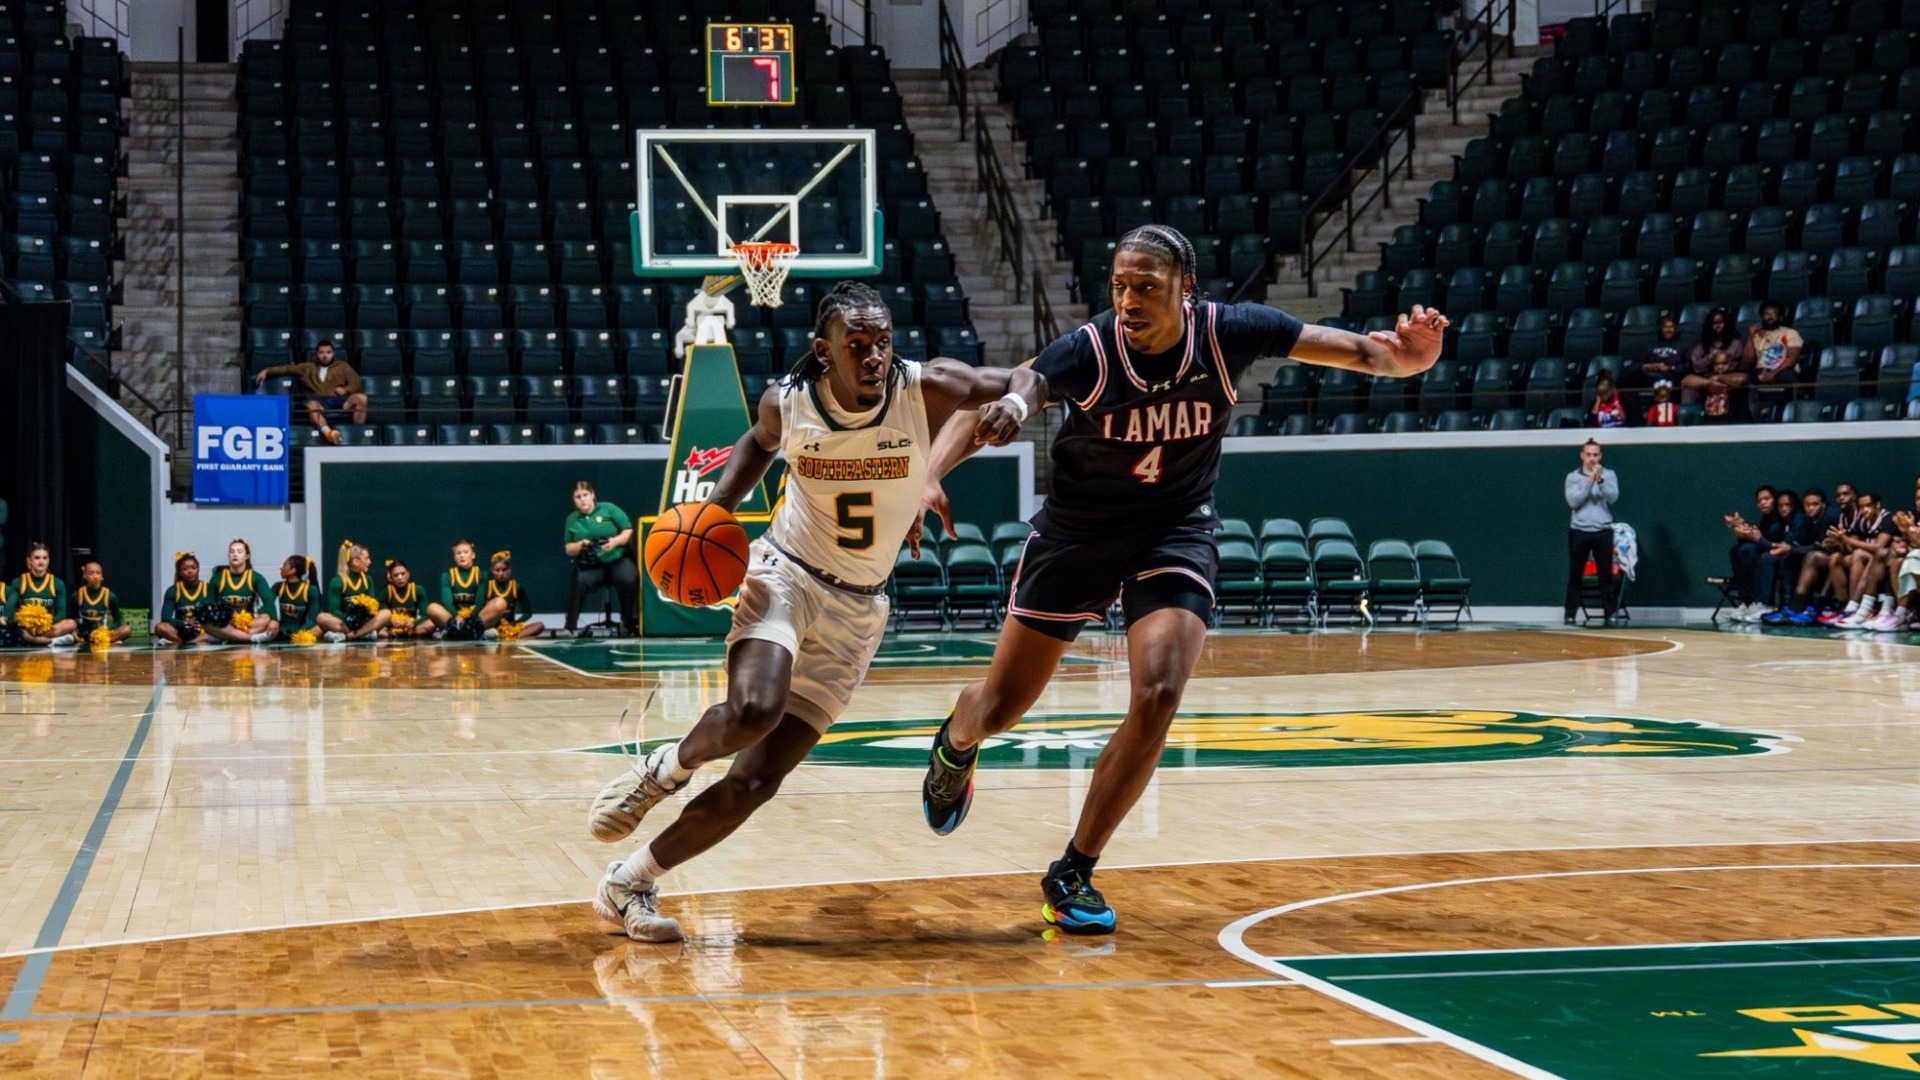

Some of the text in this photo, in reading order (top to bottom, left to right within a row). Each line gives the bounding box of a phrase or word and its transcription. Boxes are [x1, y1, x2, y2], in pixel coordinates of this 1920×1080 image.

[753, 58, 778, 100] 7
[1103, 401, 1213, 442] LAMAR
[197, 425, 284, 460] FGB
[196, 463, 285, 471] FIRST GUARANTY BANK
[798, 455, 910, 481] SOUTHEASTERN
[1132, 445, 1164, 483] 4
[834, 490, 875, 550] 5
